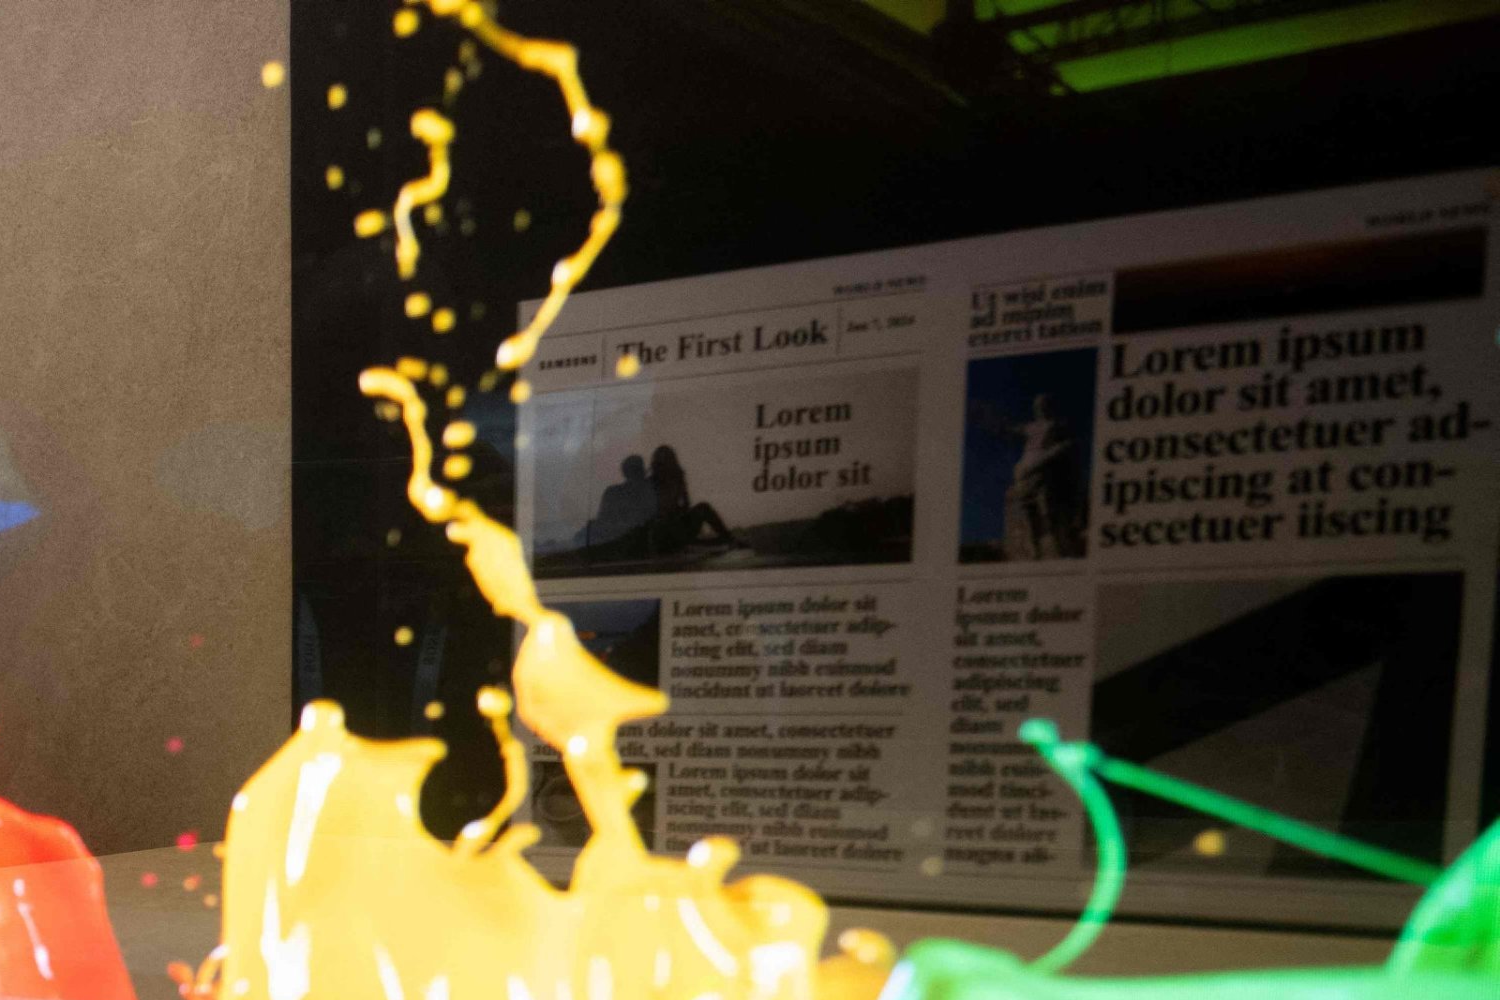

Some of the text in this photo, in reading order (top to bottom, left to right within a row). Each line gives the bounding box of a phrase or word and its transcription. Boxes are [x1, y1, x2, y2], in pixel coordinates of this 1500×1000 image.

[617, 318, 829, 367] The First Look
[1111, 322, 1427, 381] Lorem ipsum
[1106, 363, 1442, 421] dolor sit amet,
[755, 403, 852, 430] Lorem
[1104, 402, 1491, 464] consectetuer ad-
[754, 433, 842, 464] ipsum
[752, 459, 872, 495] dolor sit
[1102, 456, 1458, 514] ipiscing at con-
[1099, 498, 1453, 548] secetuer iiscing
[672, 595, 878, 619] Lorem ipsum dolor sit
[799, 639, 848, 655] diam
[648, 722, 693, 739] dolor
[698, 723, 719, 739] sit
[722, 724, 774, 740] amet,
[687, 743, 731, 759] diam
[668, 763, 727, 780] Lorem
